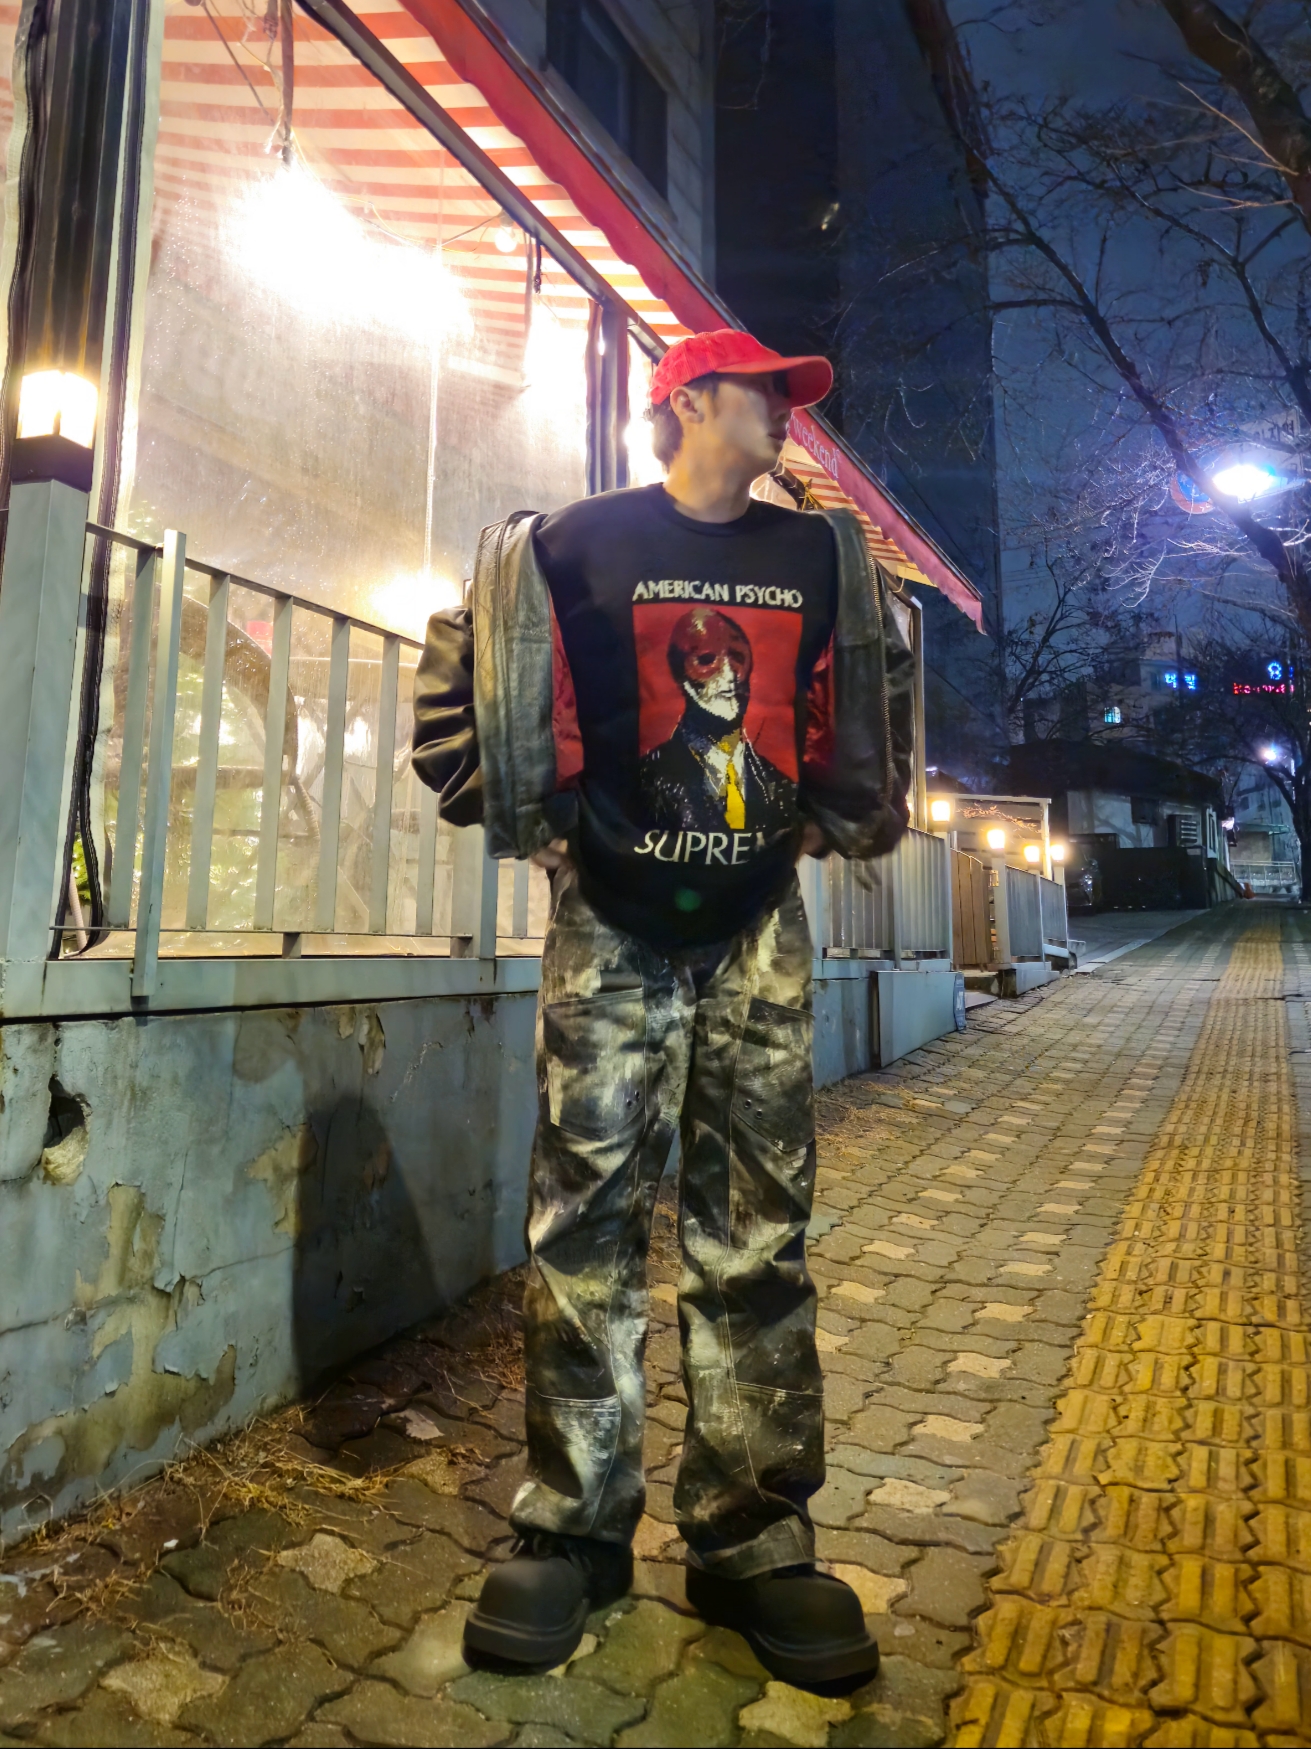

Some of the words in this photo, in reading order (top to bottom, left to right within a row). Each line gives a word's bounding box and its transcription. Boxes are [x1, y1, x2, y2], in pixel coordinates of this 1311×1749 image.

[632, 579, 730, 602] AMERICAN
[735, 584, 803, 608] PSYCHO
[633, 828, 766, 866] SUPRE
